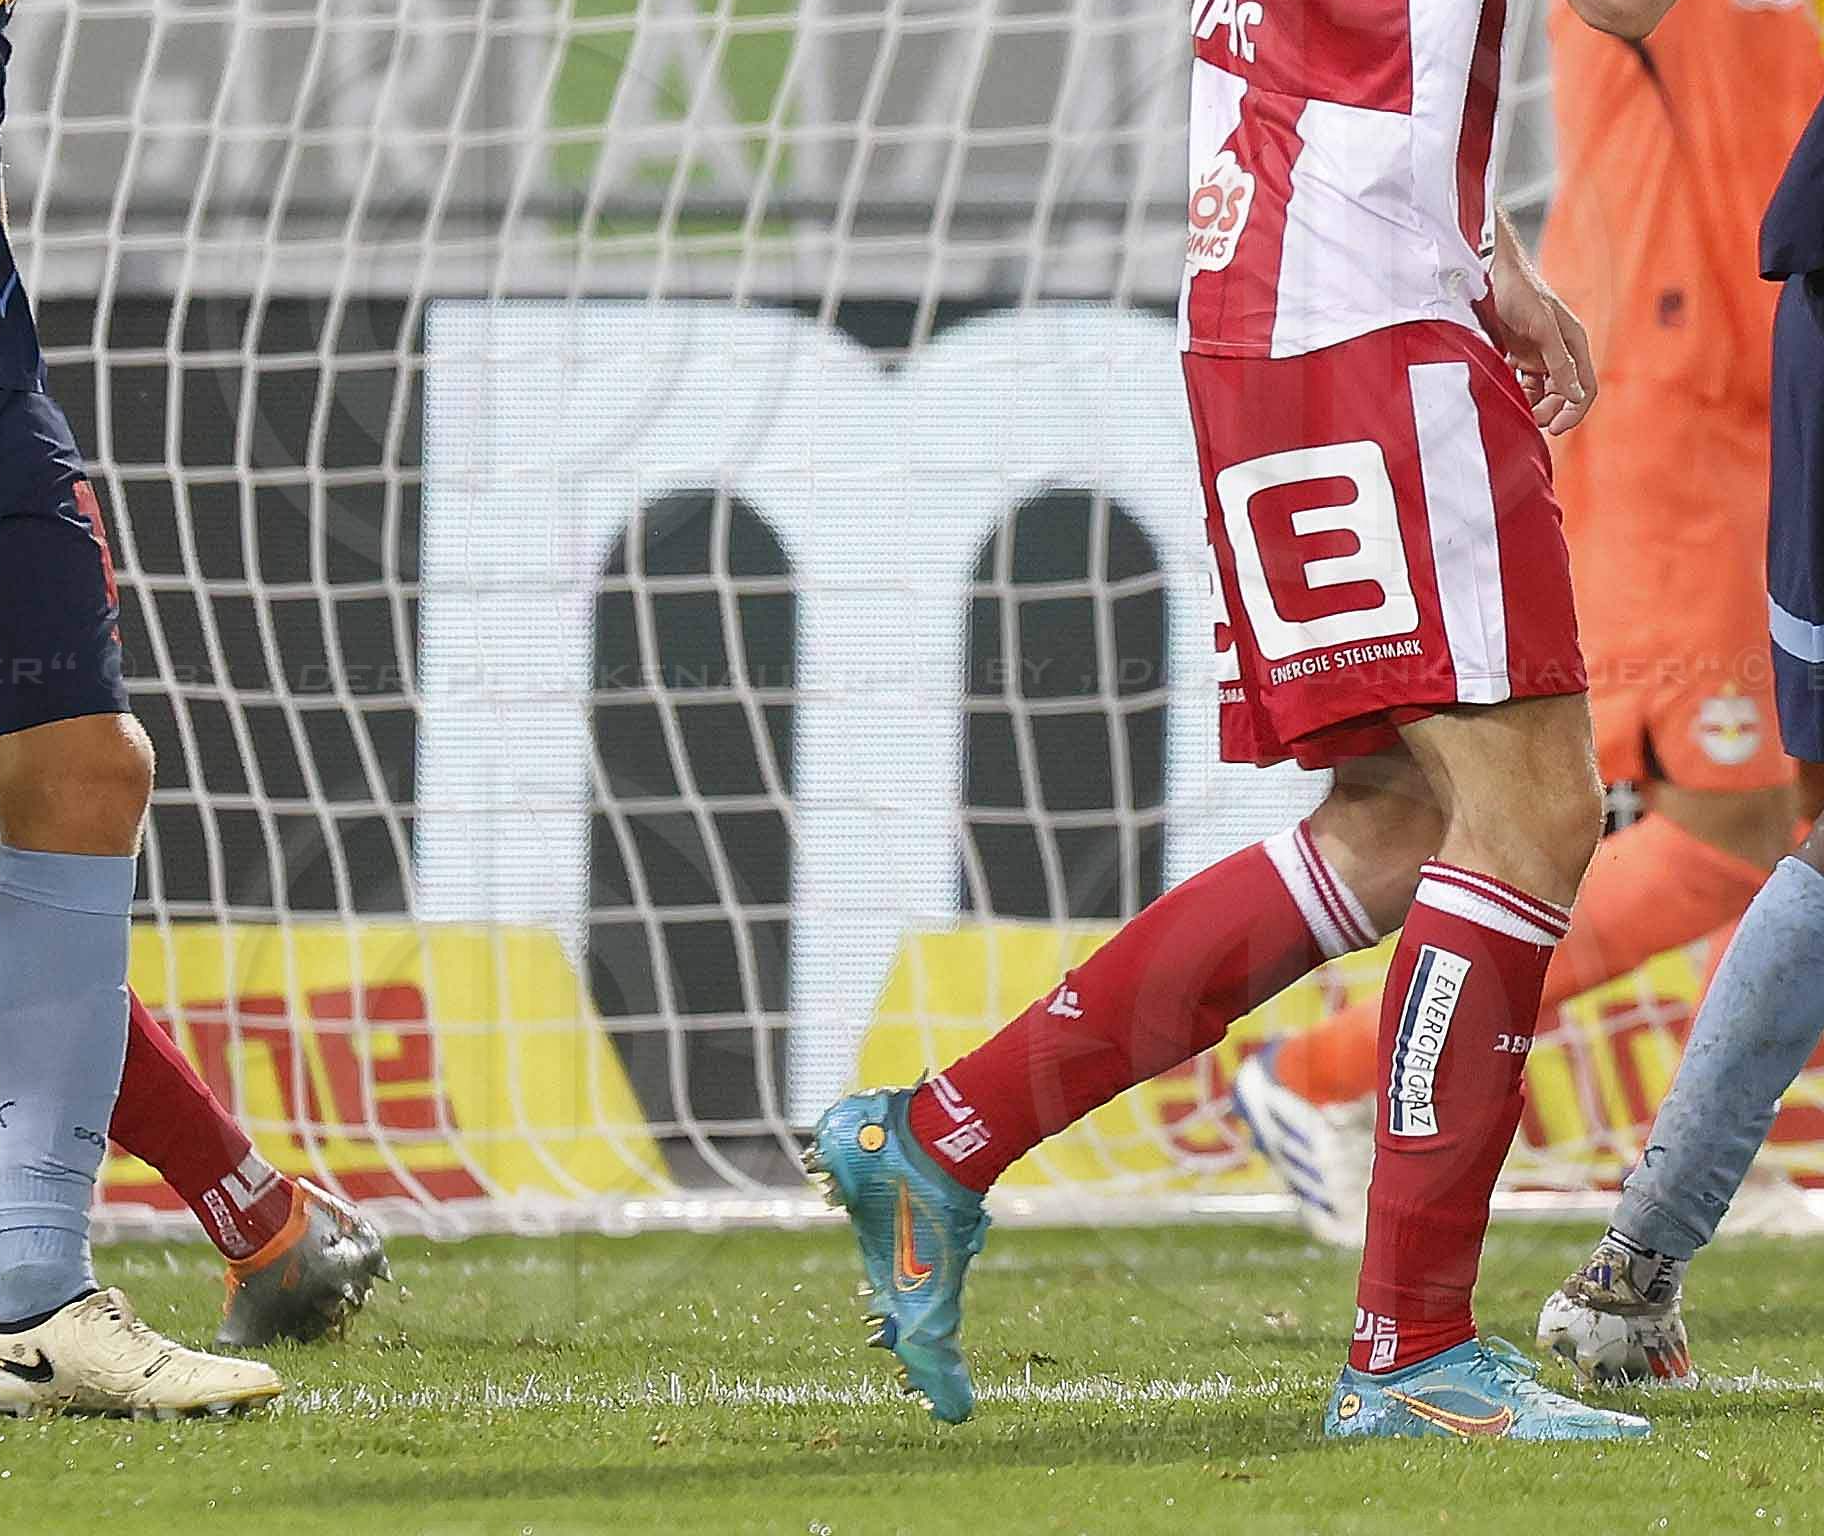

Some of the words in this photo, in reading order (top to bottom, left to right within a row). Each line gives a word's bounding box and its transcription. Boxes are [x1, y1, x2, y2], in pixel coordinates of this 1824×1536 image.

[1269, 653, 1331, 687] ENERGIE
[1334, 639, 1424, 669] STEIERMARK
[1412, 973, 1457, 1072] ENERGIE
[1407, 1073, 1432, 1127] GRAZ
